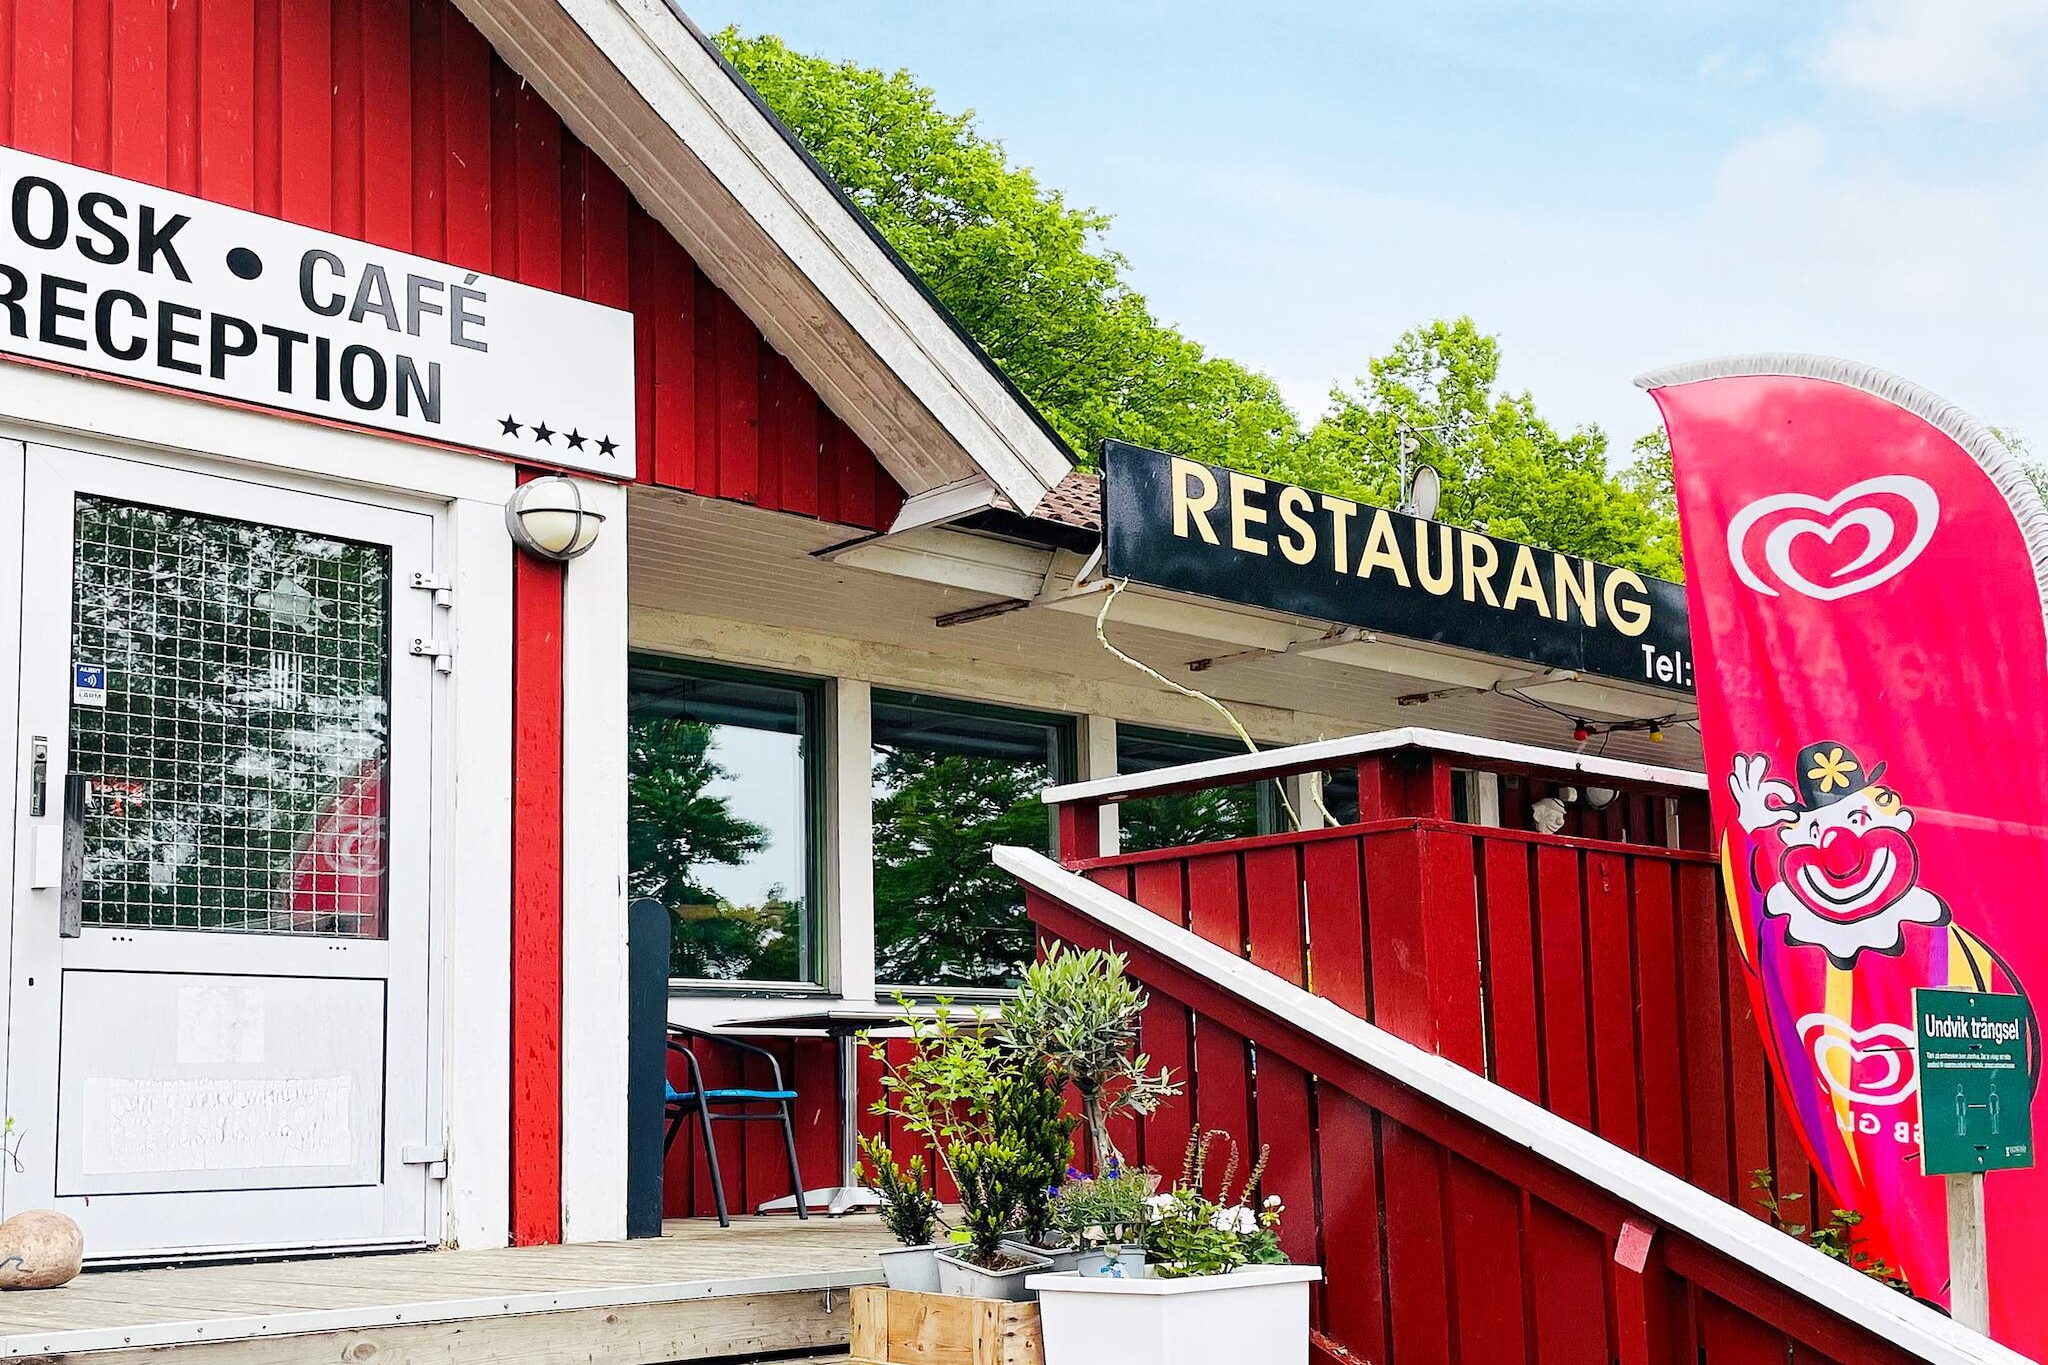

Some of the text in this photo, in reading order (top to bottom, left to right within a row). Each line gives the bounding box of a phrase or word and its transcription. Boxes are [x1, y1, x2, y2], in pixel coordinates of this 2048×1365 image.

[0, 263, 441, 425] RECEPTION
[299, 248, 488, 353] CAFÉ
[1170, 457, 1653, 637] RESTAURANG
[1641, 643, 1692, 687] Tel:
[1925, 1014, 2020, 1045] Undvik trängsel
